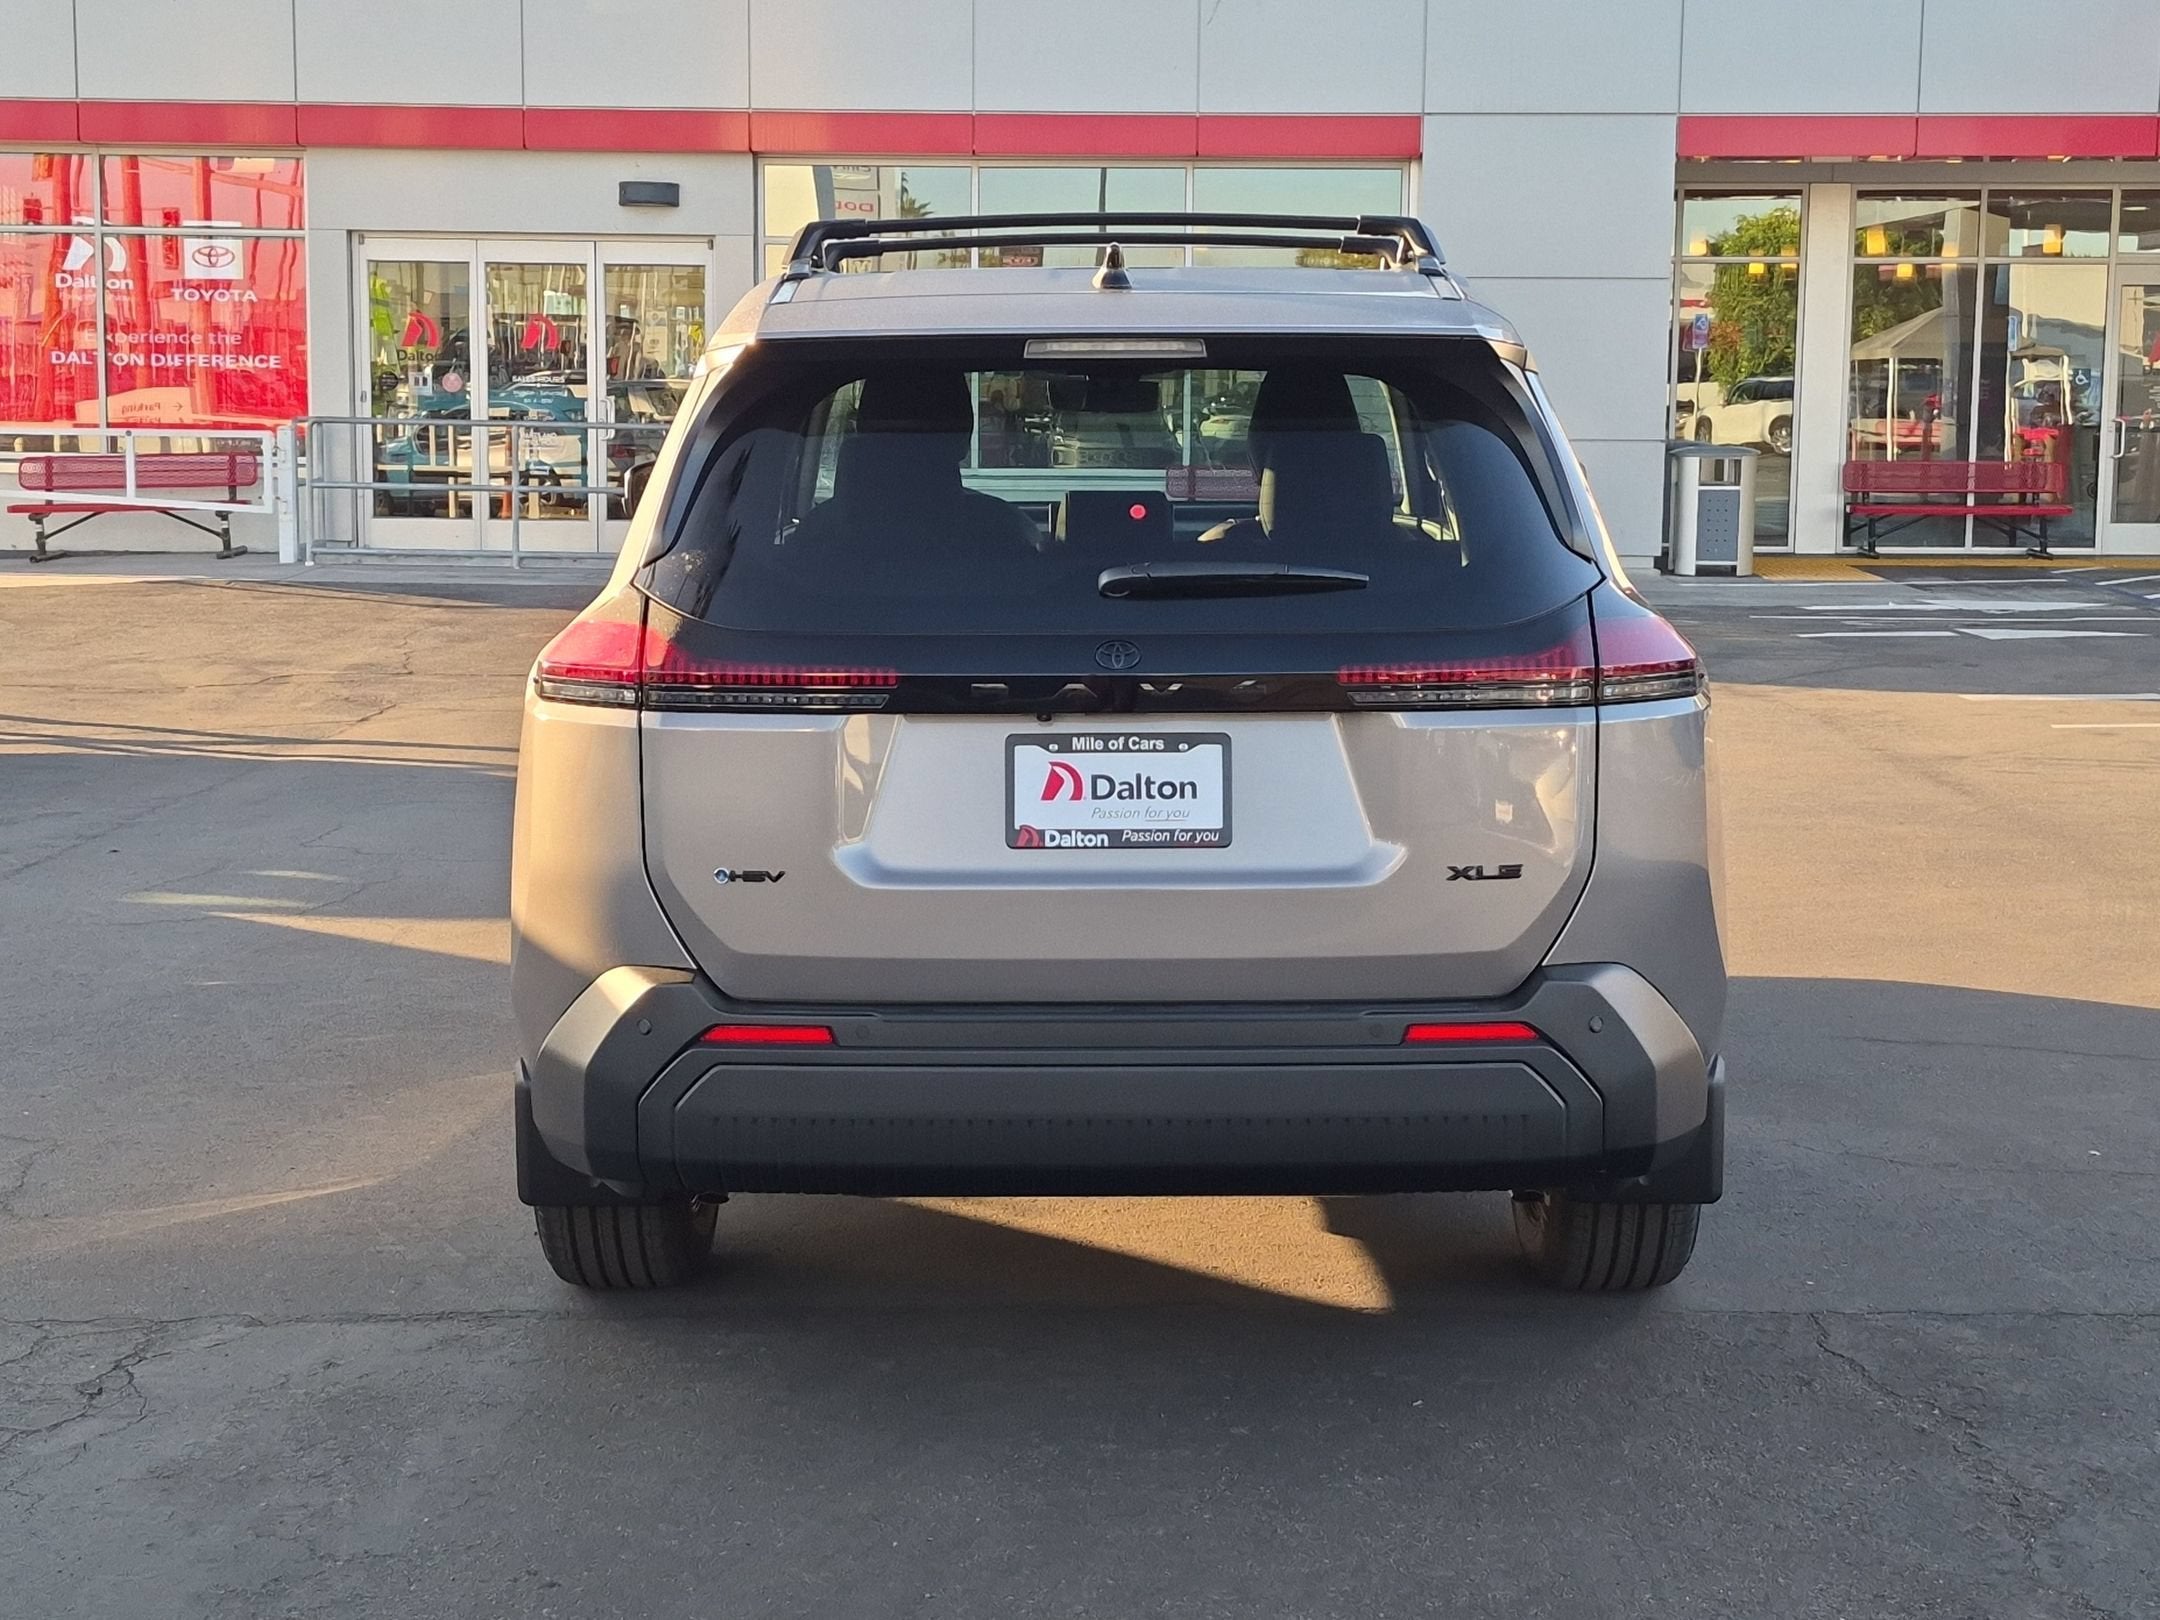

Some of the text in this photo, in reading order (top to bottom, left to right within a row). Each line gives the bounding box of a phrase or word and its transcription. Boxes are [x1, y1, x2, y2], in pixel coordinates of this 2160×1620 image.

[55, 273, 134, 289] Dalton
[171, 288, 258, 303] TOYOTA
[208, 331, 242, 345] the
[151, 353, 282, 369] DIFFERENCE
[1072, 736, 1165, 751] Mile of Cars
[1091, 772, 1198, 800] Dalton
[1091, 806, 1190, 821] Passion for you
[1044, 829, 1220, 847] Dalton Passion for you
